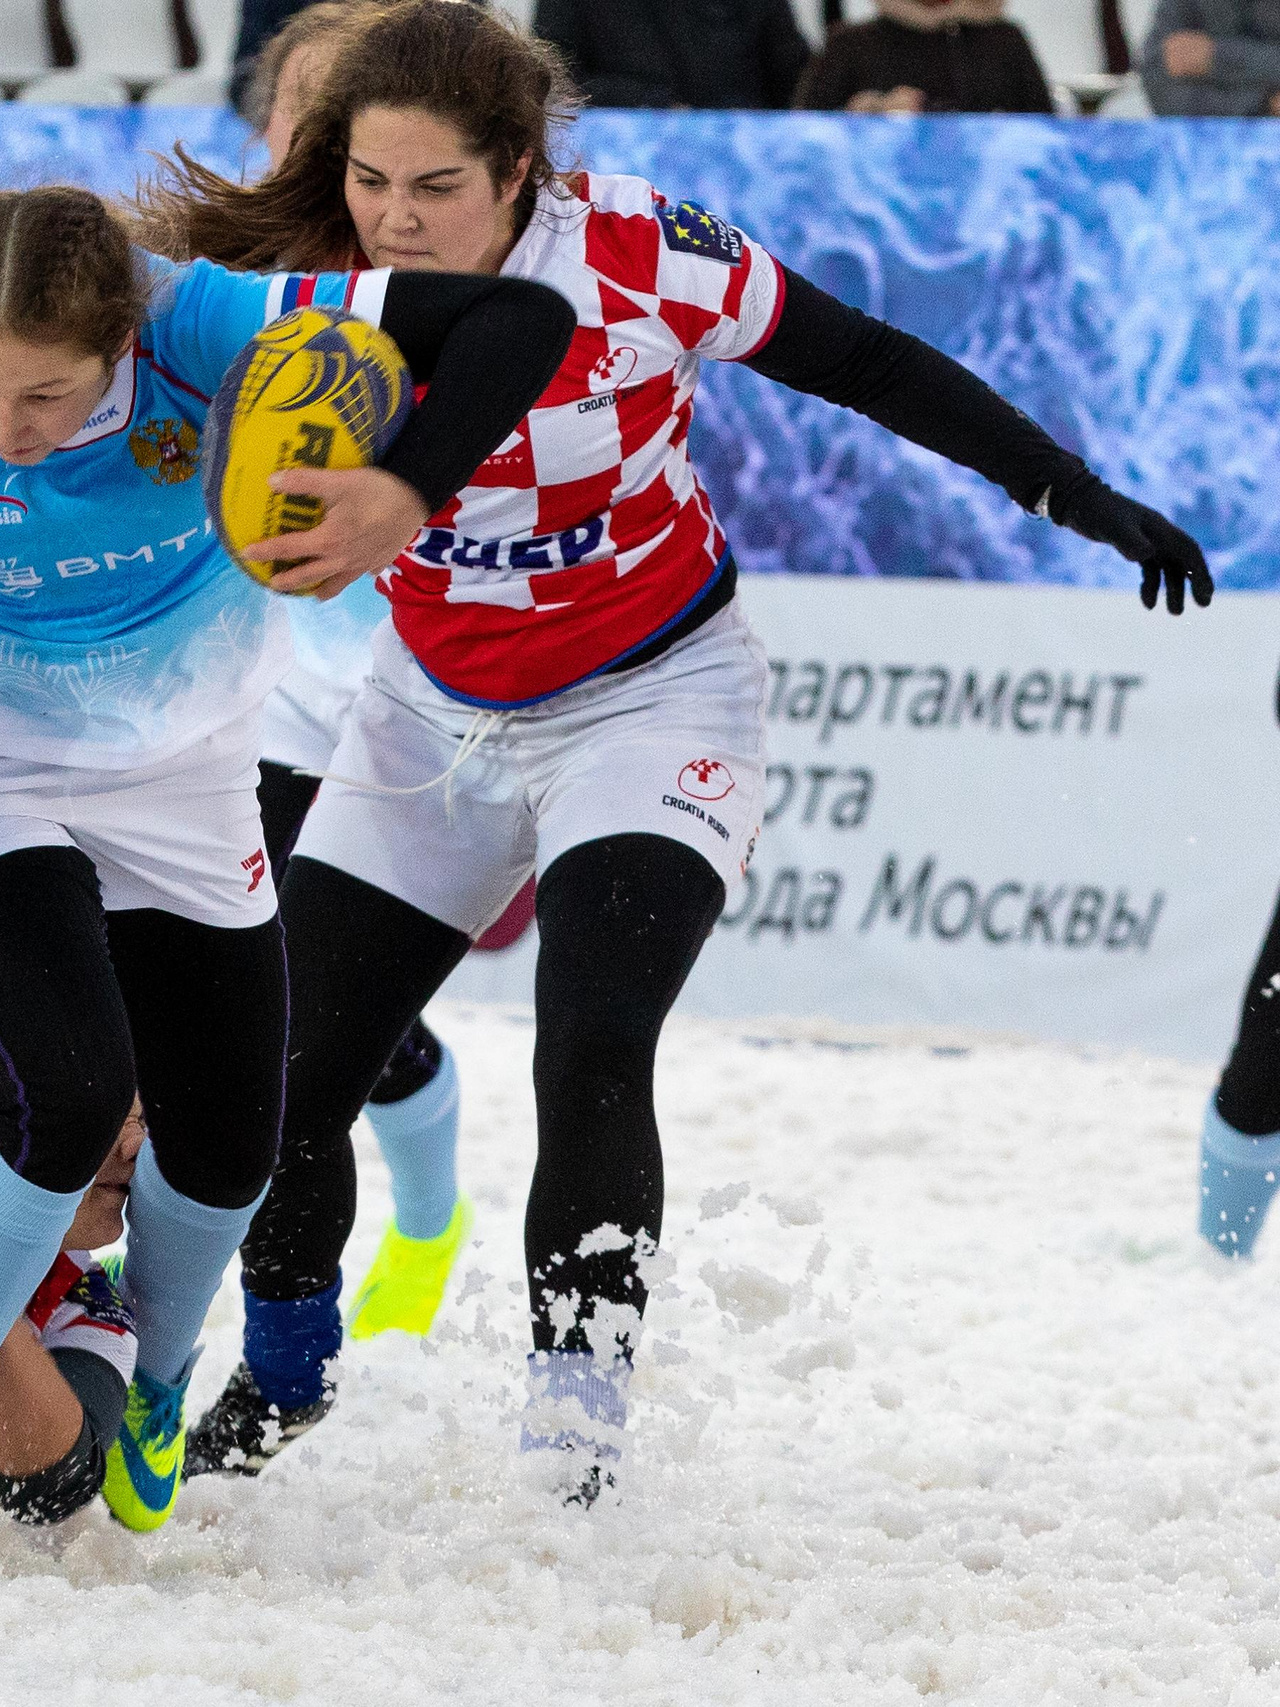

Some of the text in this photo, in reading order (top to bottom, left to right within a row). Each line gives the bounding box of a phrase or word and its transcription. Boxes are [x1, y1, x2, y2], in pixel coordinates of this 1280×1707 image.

[577, 393, 618, 415] CROATIA
[661, 794, 731, 842] CROATIA RUGBY
[857, 849, 1167, 953] Москвы
